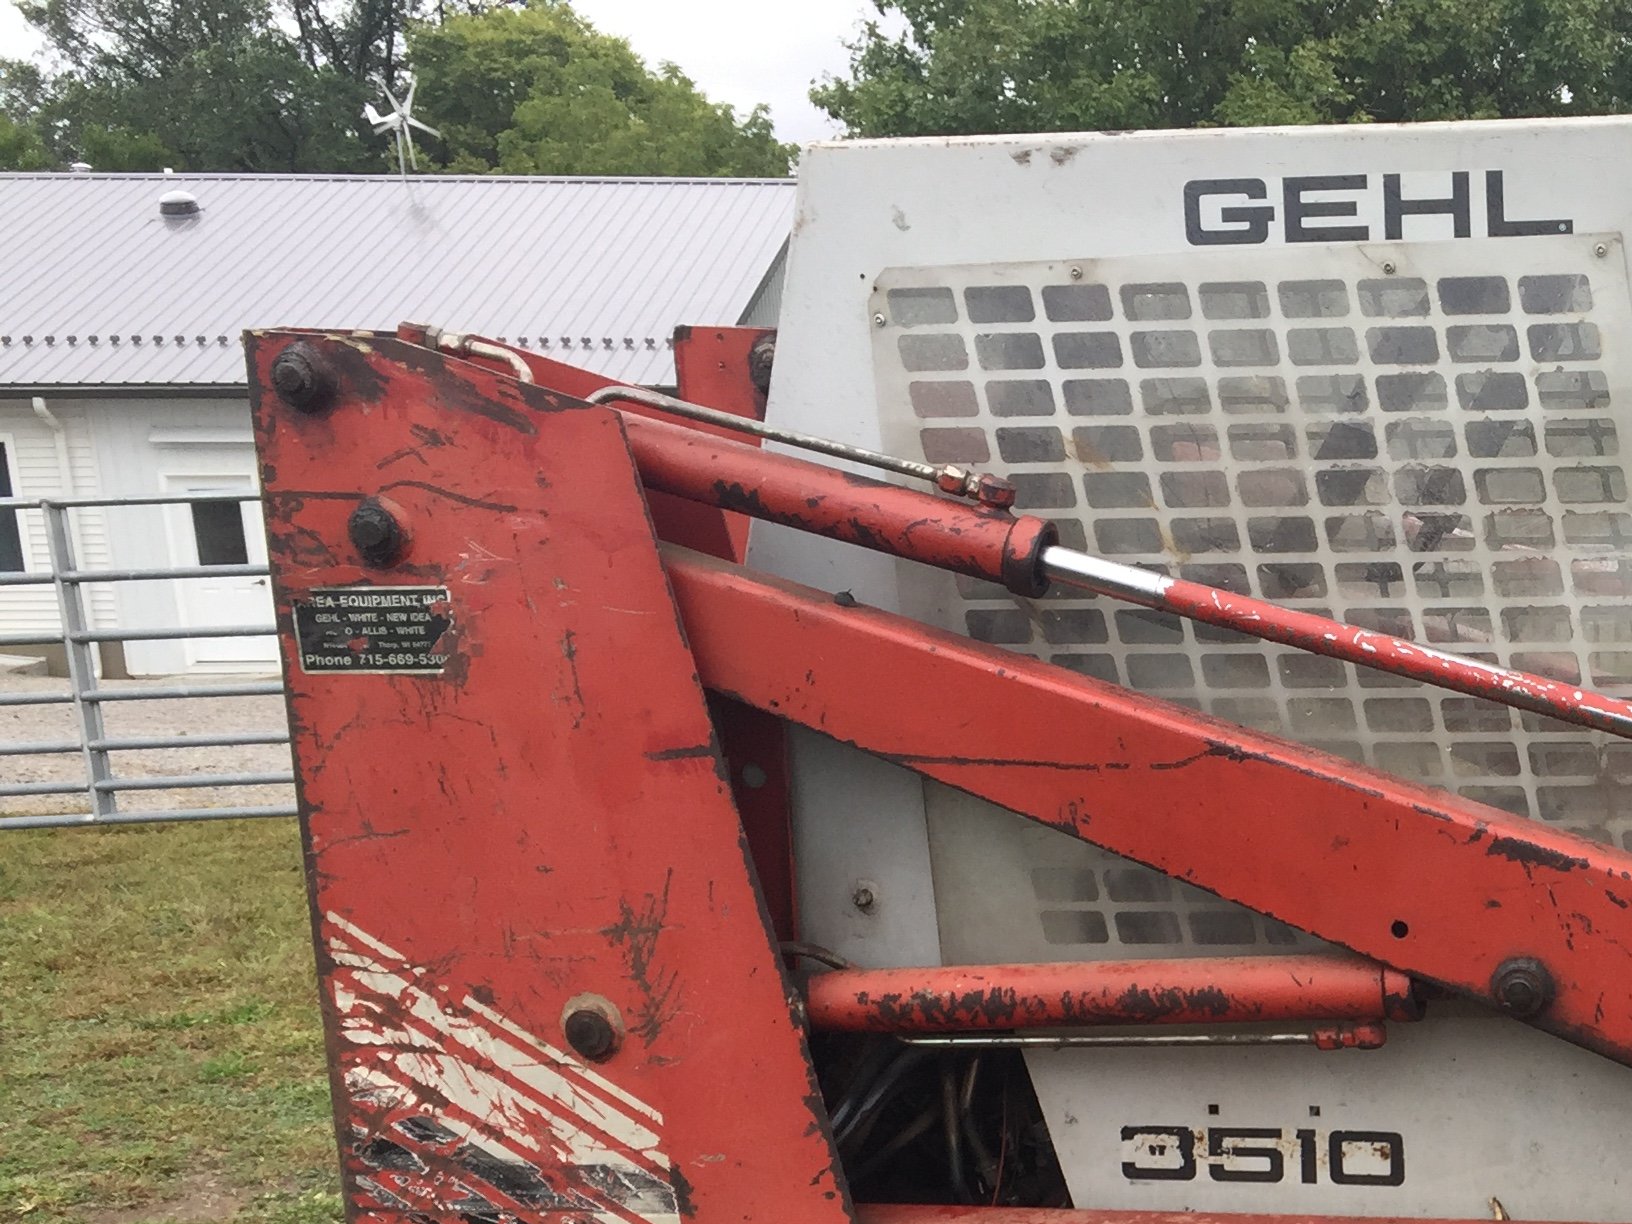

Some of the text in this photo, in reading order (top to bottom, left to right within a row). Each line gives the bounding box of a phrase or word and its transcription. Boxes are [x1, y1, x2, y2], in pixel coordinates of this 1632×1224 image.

[1183, 169, 1574, 246] GEHL
[315, 612, 341, 623] GEHL
[348, 613, 378, 622] WHITE
[386, 613, 408, 622] NEW
[410, 613, 432, 622] IDEA
[361, 626, 388, 635] ALLIS
[396, 626, 426, 635] WHITE
[305, 653, 352, 666] Phone
[1120, 1125, 1405, 1186] 3510
